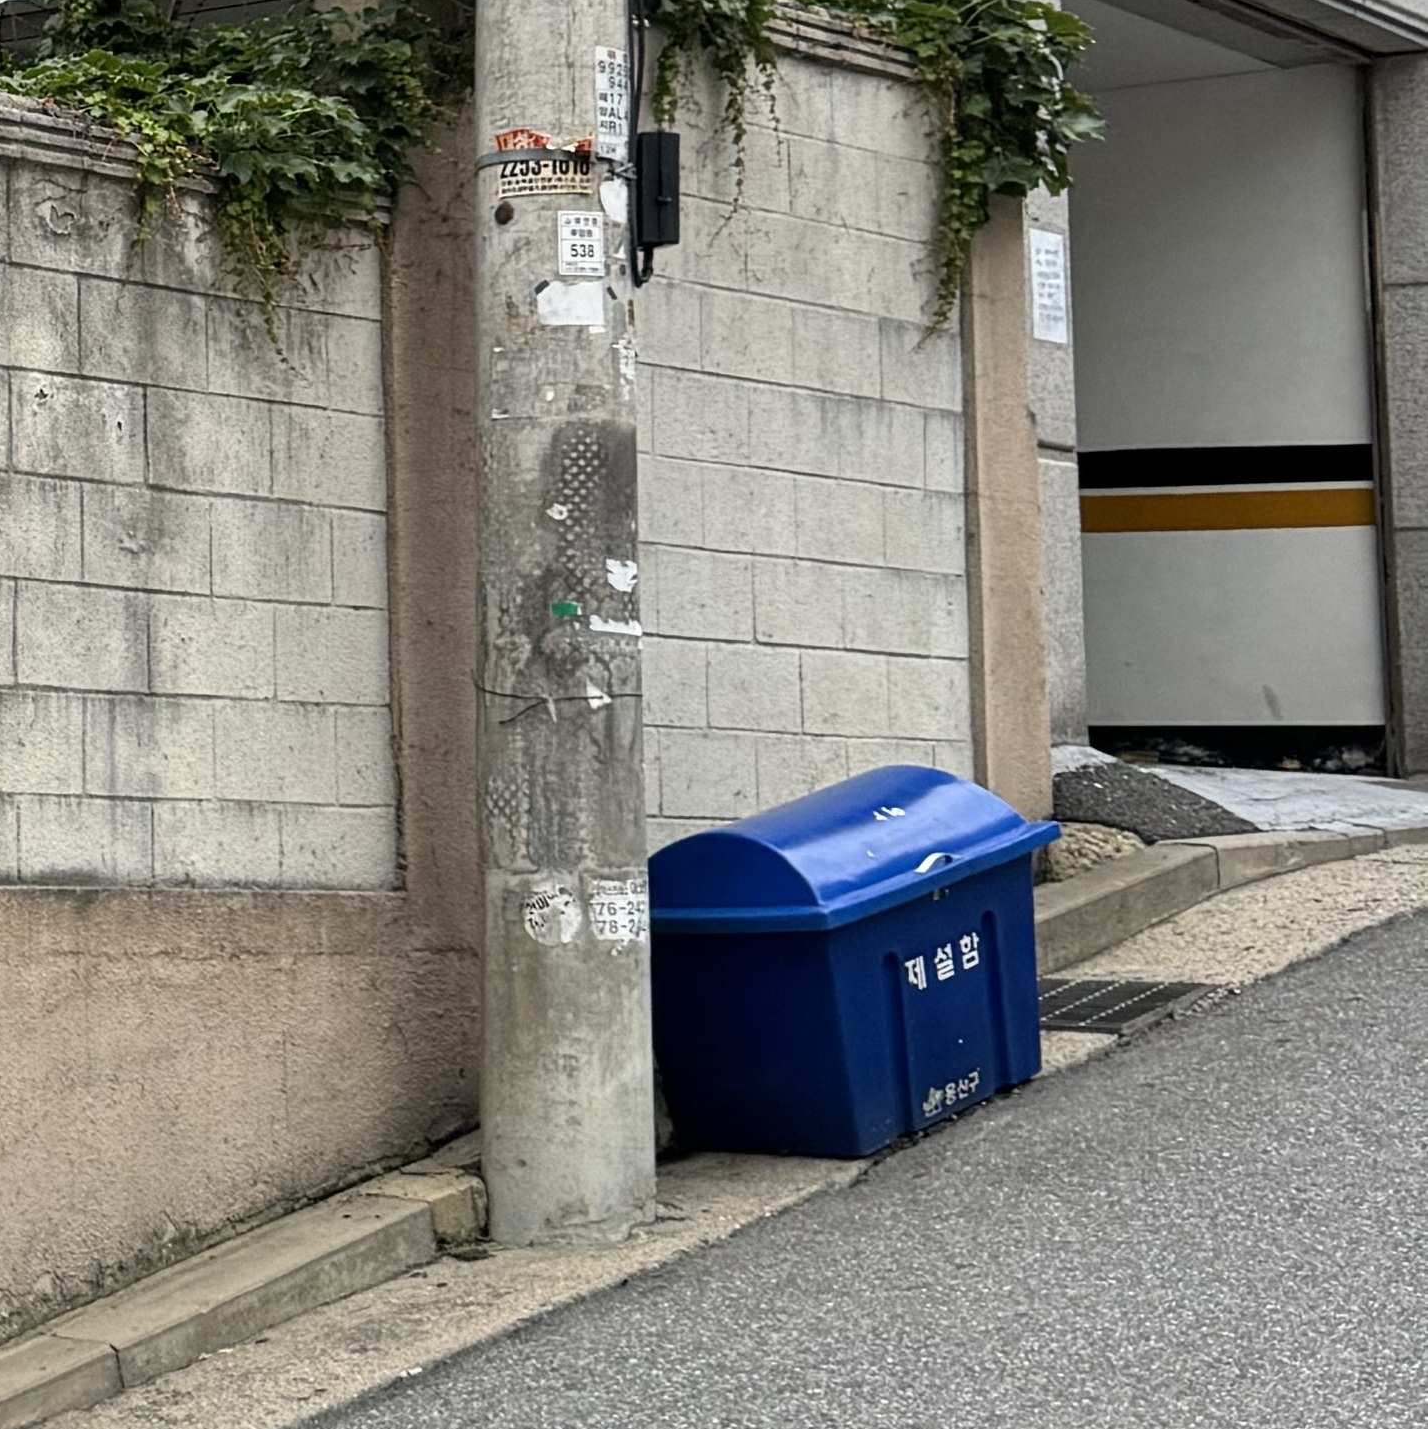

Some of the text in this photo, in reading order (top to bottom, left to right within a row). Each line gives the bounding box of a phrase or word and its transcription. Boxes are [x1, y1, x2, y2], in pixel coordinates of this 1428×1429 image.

[570, 243, 595, 258] 538
[904, 932, 979, 990] 제설함
[945, 1071, 980, 1105] 용산구
